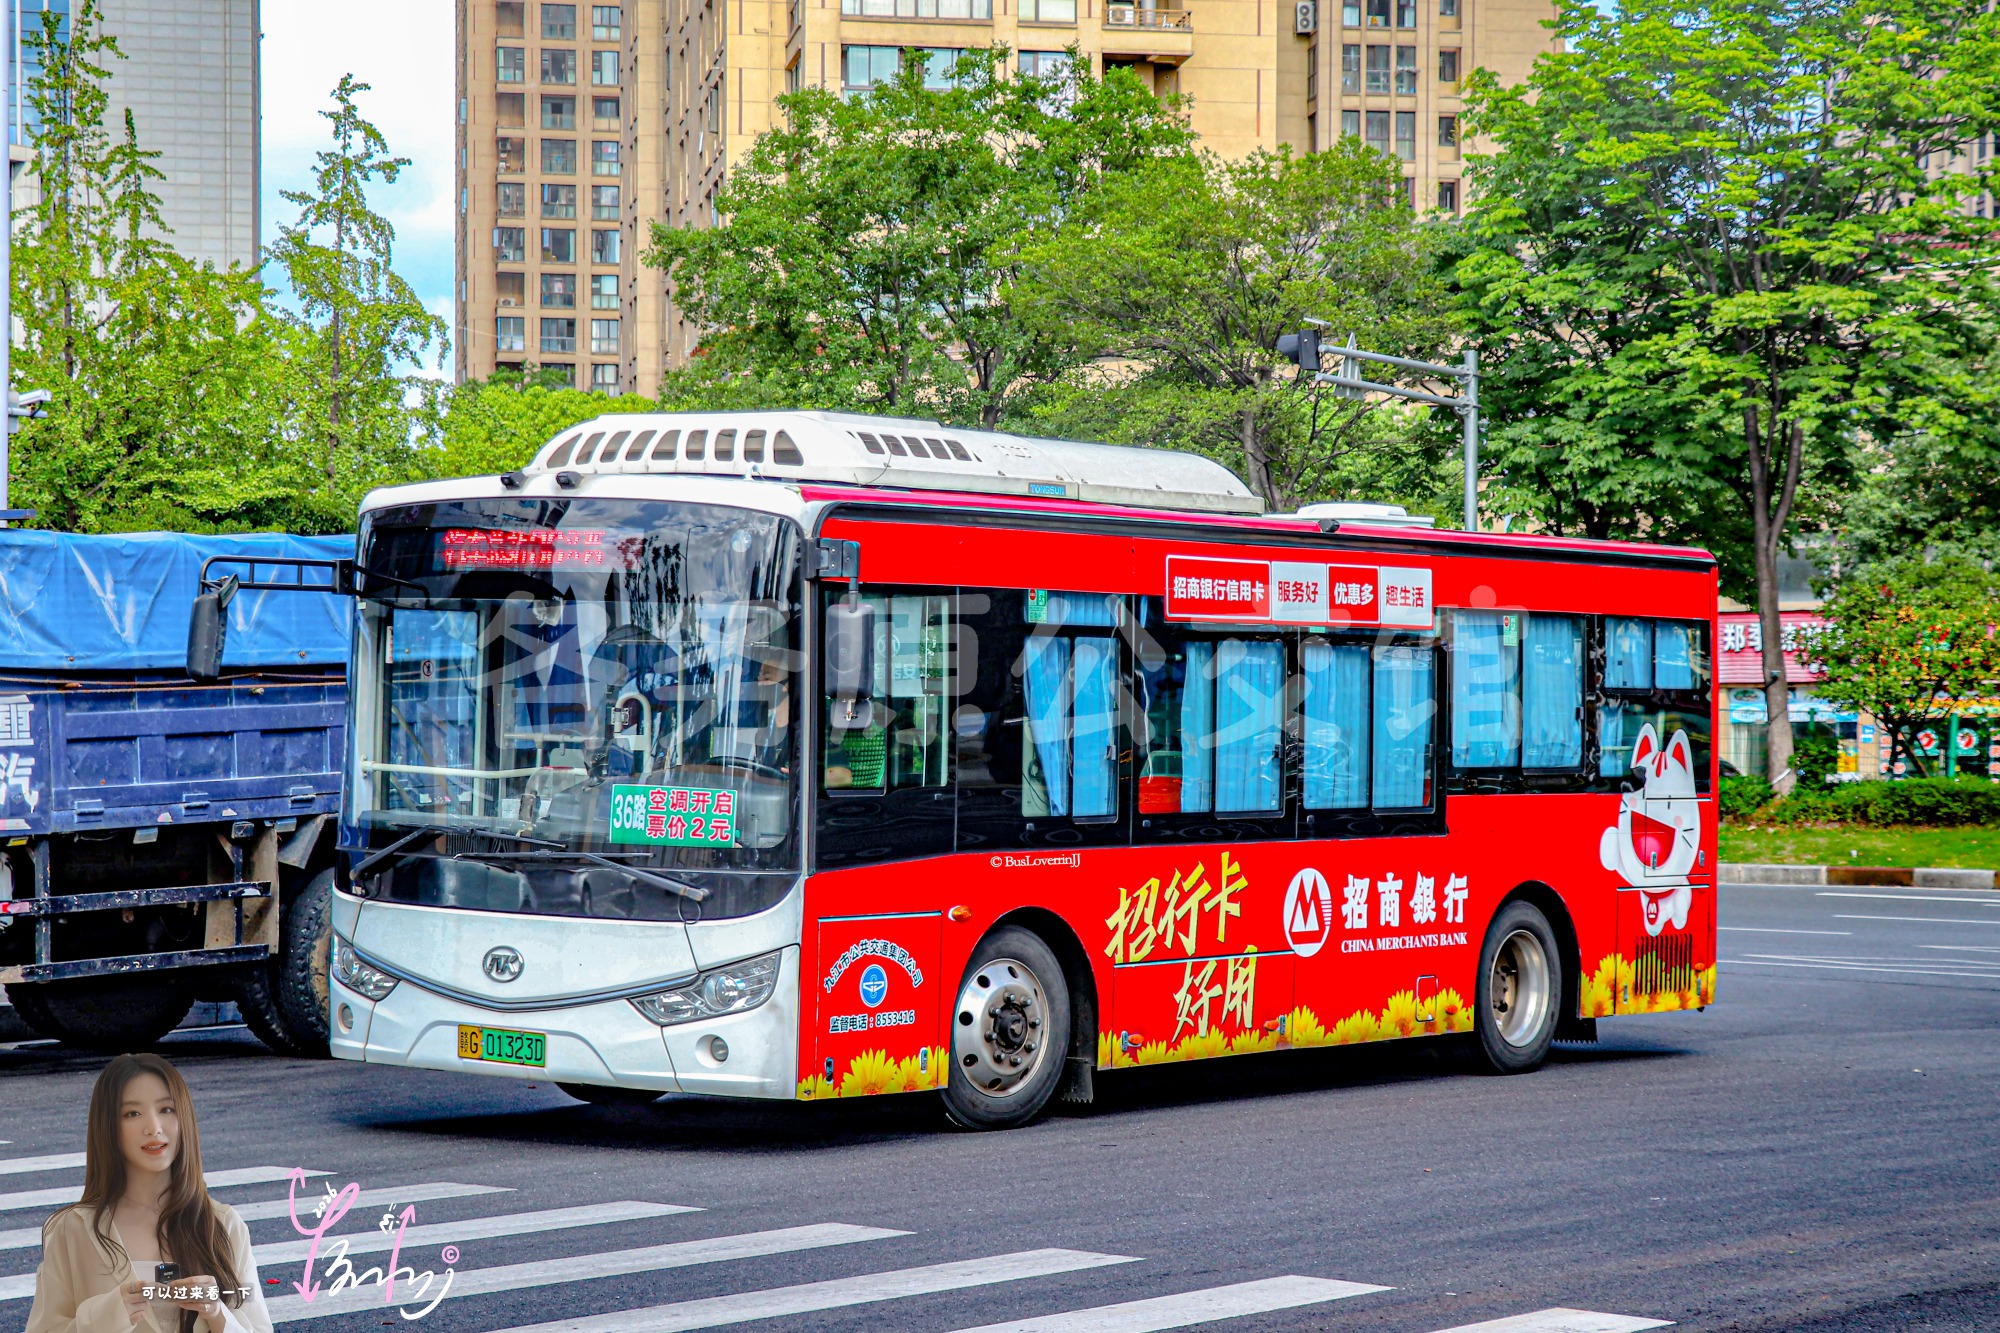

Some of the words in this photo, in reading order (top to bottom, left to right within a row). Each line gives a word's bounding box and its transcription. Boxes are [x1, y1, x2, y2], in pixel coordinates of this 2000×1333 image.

[1029, 484, 1065, 496] TONGSUN
[1173, 576, 1265, 602] 招商银行信用卡
[1277, 580, 1319, 604] 服务好
[1333, 582, 1375, 606] 优惠多
[1385, 585, 1425, 608] 趣生活
[613, 794, 647, 831] 36路
[648, 788, 733, 815] 空调开启
[646, 815, 731, 842] 票价2元
[1104, 851, 1248, 967] 招行卡
[1341, 939, 1375, 953] CHINA
[1376, 933, 1439, 950] MERCHANTS
[1439, 932, 1468, 946] BANK
[824, 938, 923, 993] 九江市公共交通集团公司
[1172, 944, 1258, 1043] 好用
